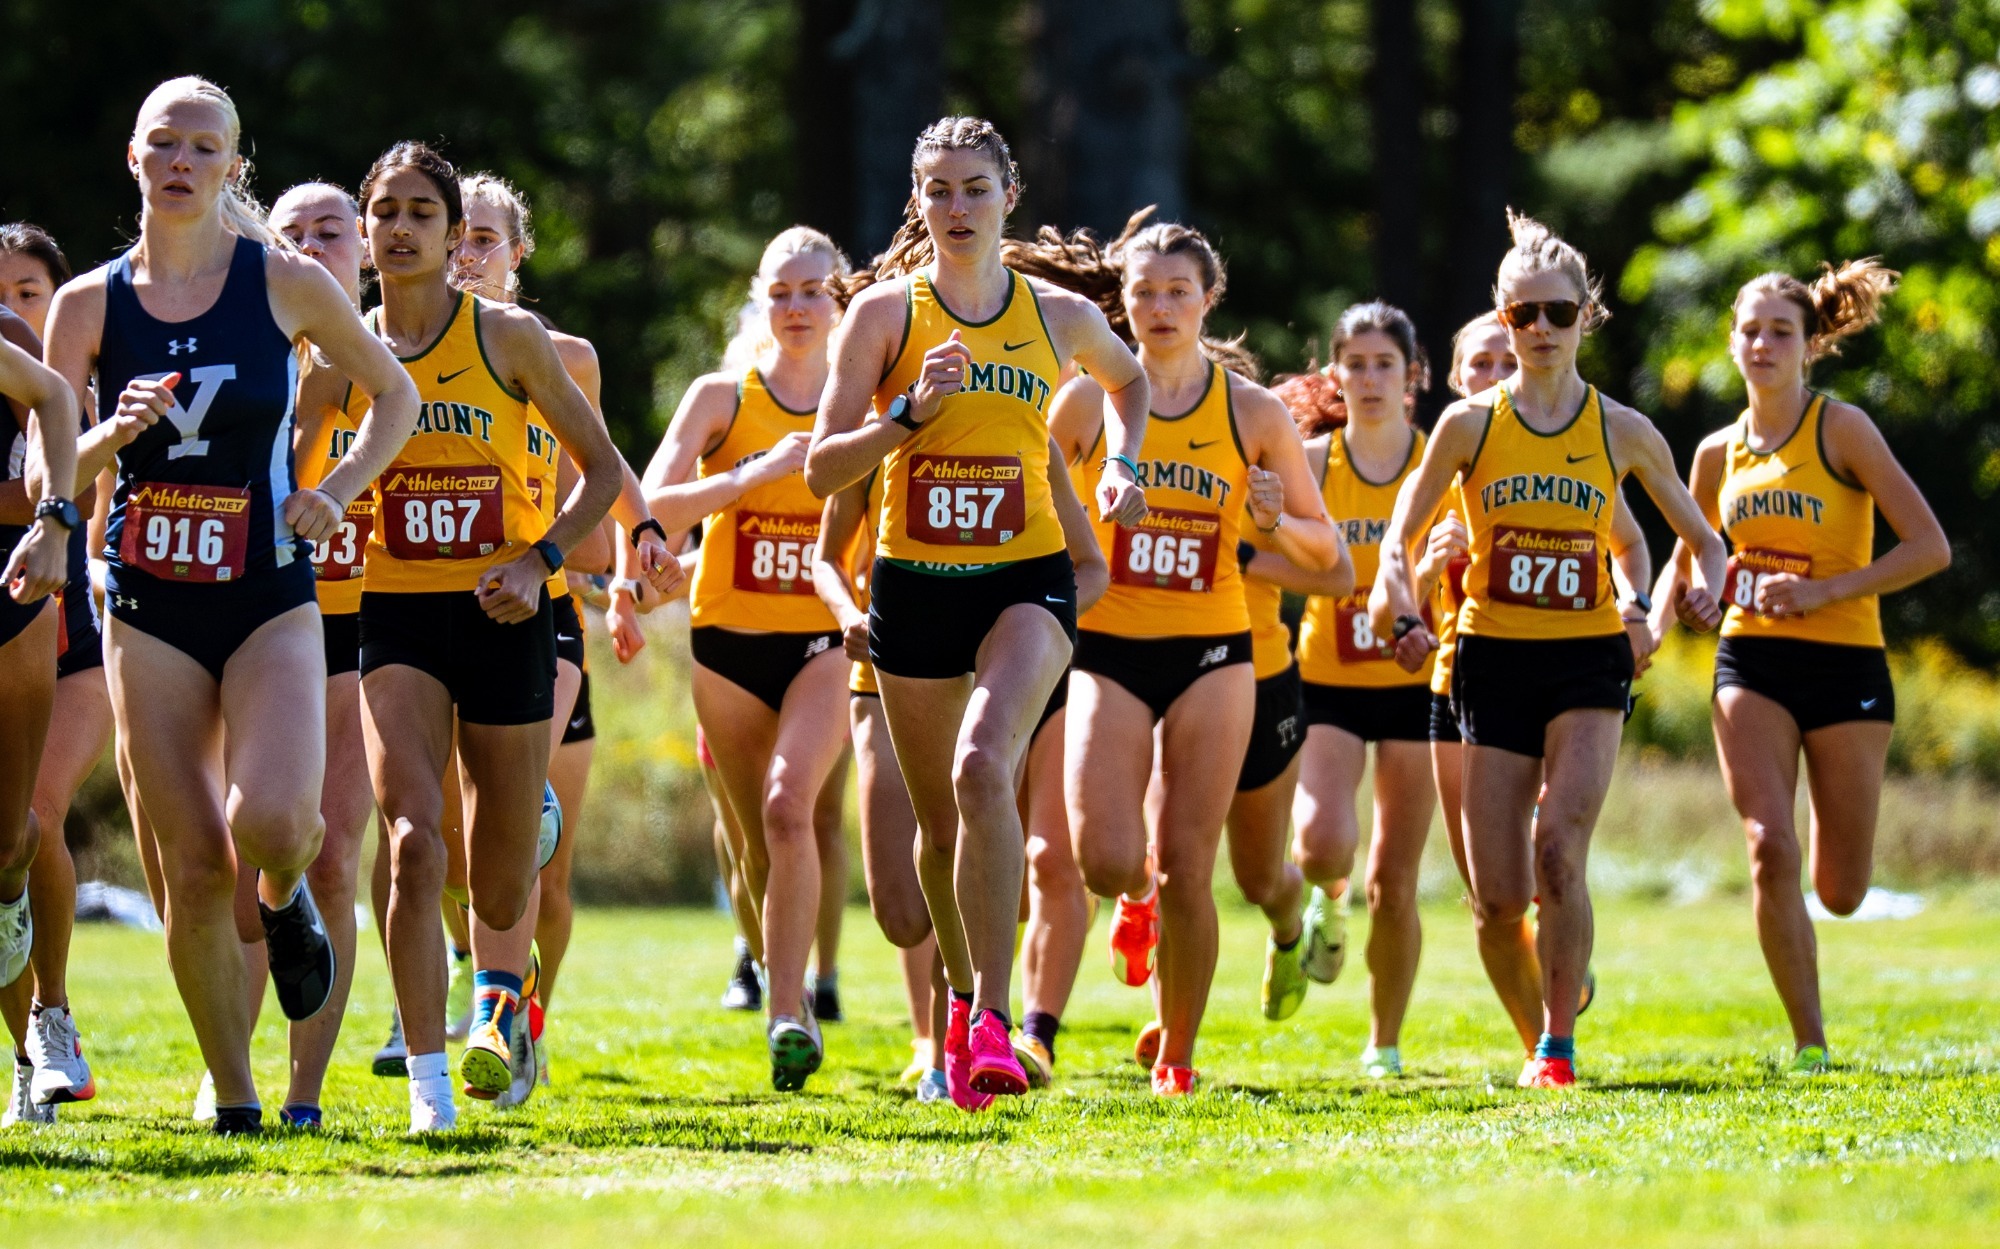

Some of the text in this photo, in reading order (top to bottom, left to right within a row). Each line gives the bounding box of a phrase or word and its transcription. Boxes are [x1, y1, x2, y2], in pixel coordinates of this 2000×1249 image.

[134, 364, 236, 460] Y
[386, 473, 495, 491] Athletic NET
[912, 460, 1017, 479] Athletic NET
[1135, 460, 1231, 507] RMONT
[130, 486, 242, 511] Athletic NET
[928, 486, 1005, 529] 857
[1480, 473, 1607, 518] VERMONT
[145, 515, 225, 565] 916
[404, 499, 481, 543] 867
[1495, 530, 1571, 552] Athletic
[1128, 532, 1202, 578] 865
[1508, 554, 1581, 598] 876
